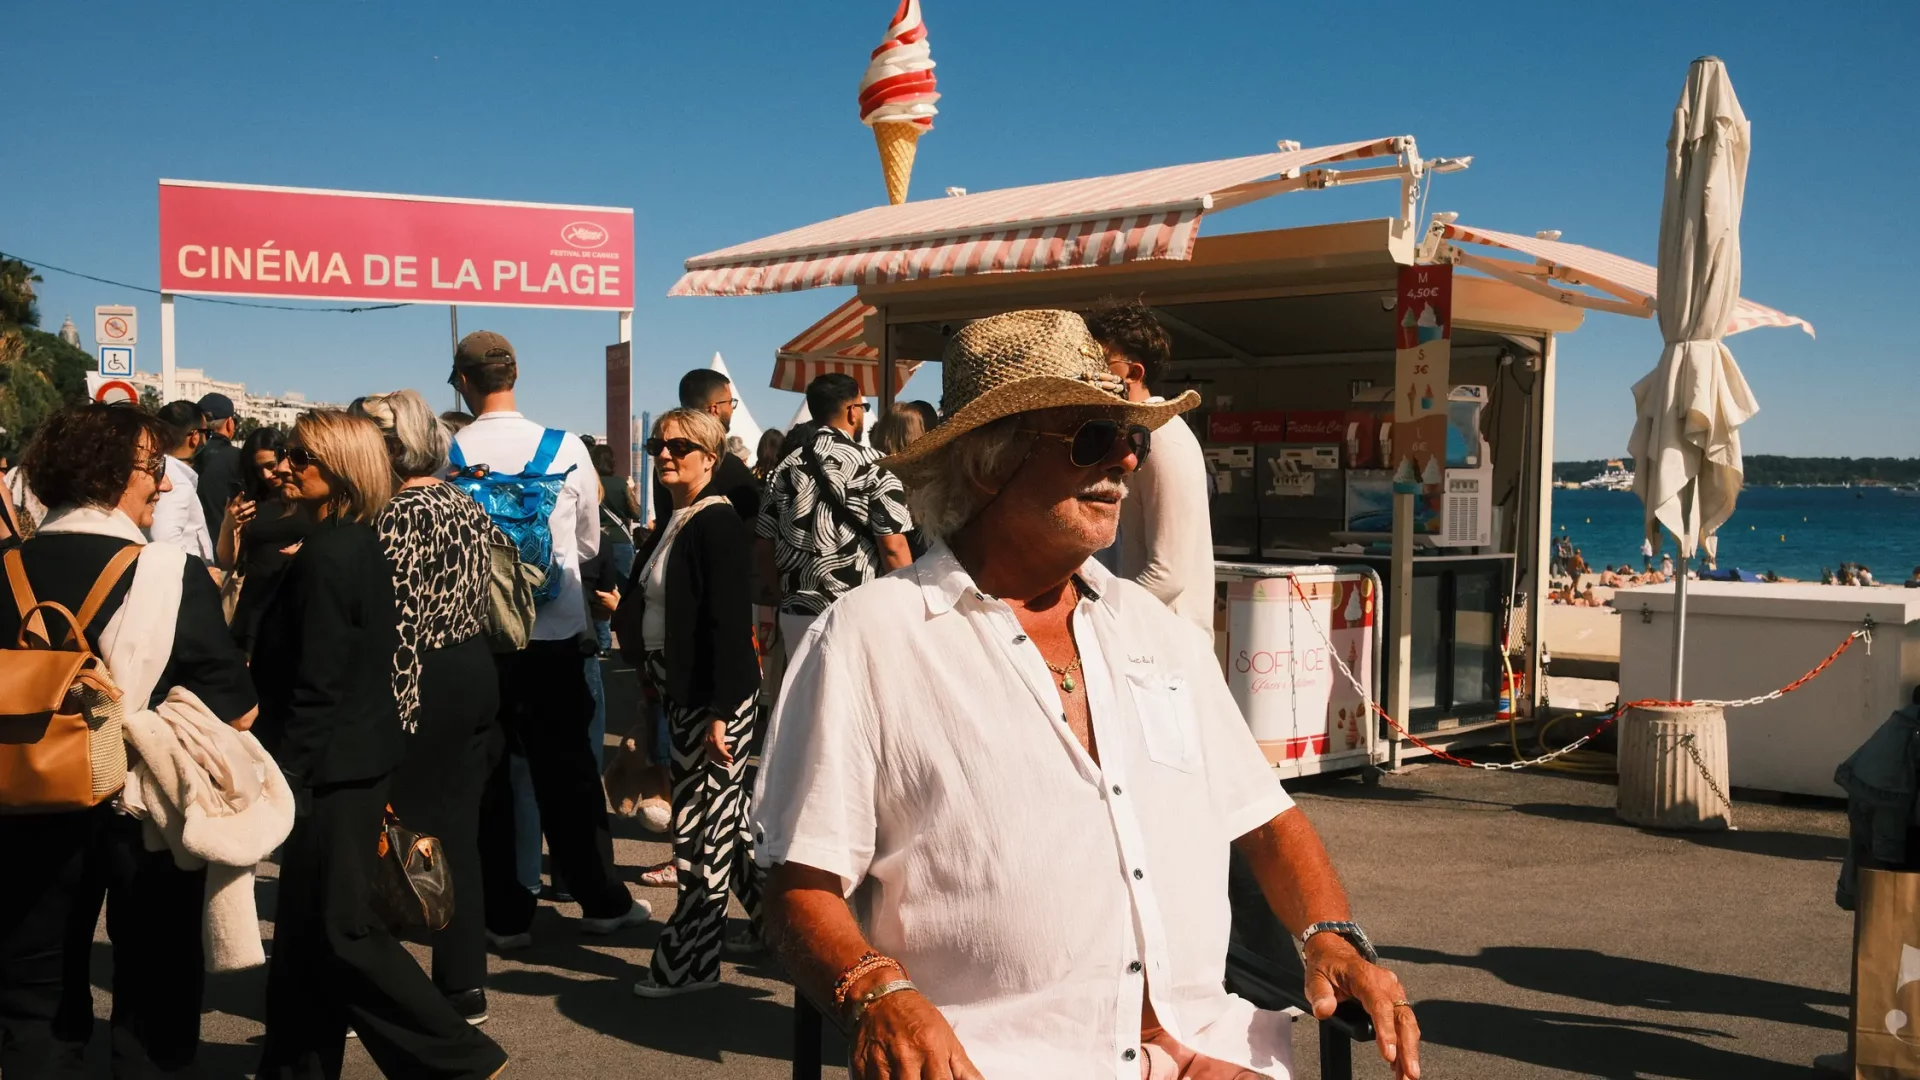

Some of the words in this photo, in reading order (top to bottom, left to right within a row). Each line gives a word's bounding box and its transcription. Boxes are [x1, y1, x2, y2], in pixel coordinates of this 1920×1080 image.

[550, 249, 581, 258] FESTIVAL
[592, 252, 619, 260] CANNES
[178, 240, 352, 285] CINÉMA
[363, 254, 418, 288] DE
[431, 257, 482, 291] LA
[493, 260, 620, 296] PLAGE
[1418, 272, 1428, 284] M
[1407, 287, 1439, 300] 4,50€
[1418, 349, 1425, 361] S
[1413, 365, 1429, 375] 3€
[1236, 650, 1294, 675] SOFT
[1302, 648, 1325, 672] ICE
